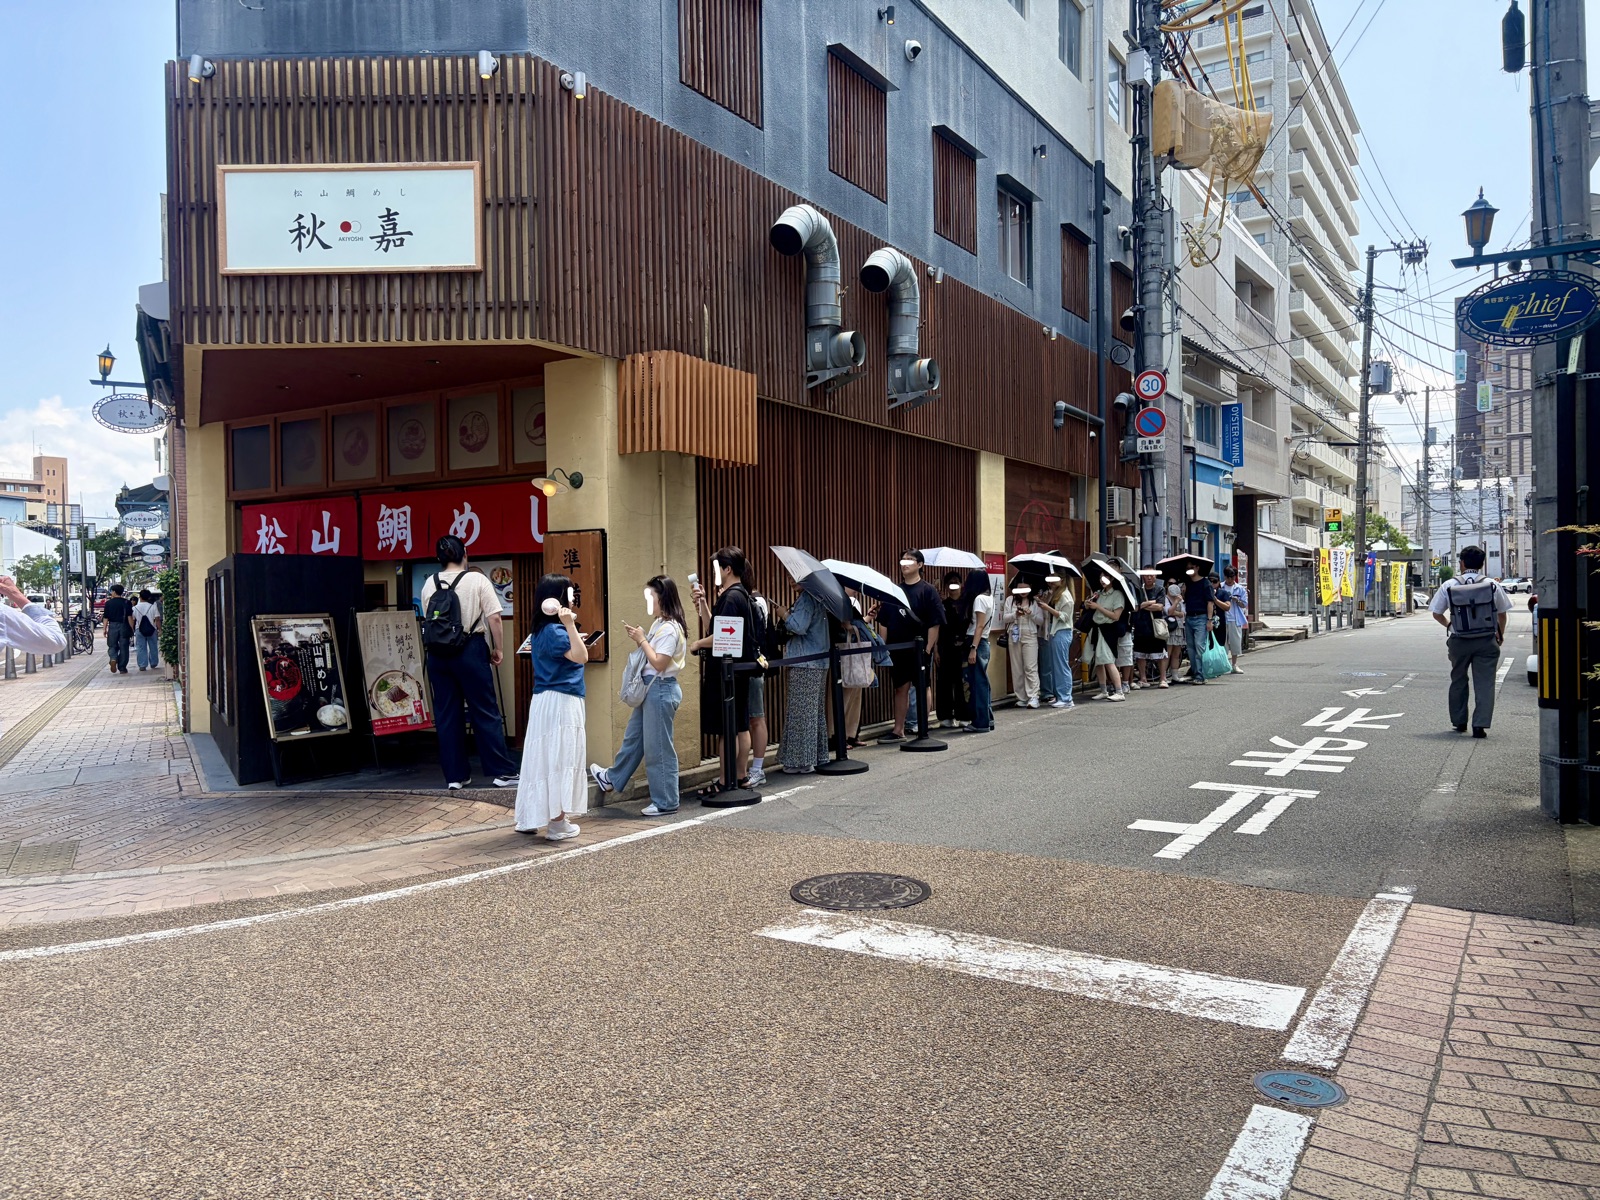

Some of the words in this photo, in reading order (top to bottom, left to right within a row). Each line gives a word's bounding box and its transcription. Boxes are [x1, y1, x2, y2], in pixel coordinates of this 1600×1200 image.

[293, 188, 407, 198] 松山鯛めし
[1515, 287, 1579, 321] chief
[1142, 378, 1160, 392] 30
[1231, 406, 1240, 437] OYSTER
[1232, 442, 1240, 464] WINE
[1333, 509, 1341, 518] P
[1328, 523, 1339, 531] 空
[310, 633, 328, 691] 松山鯛めし
[1127, 706, 1405, 860] 止まれ
